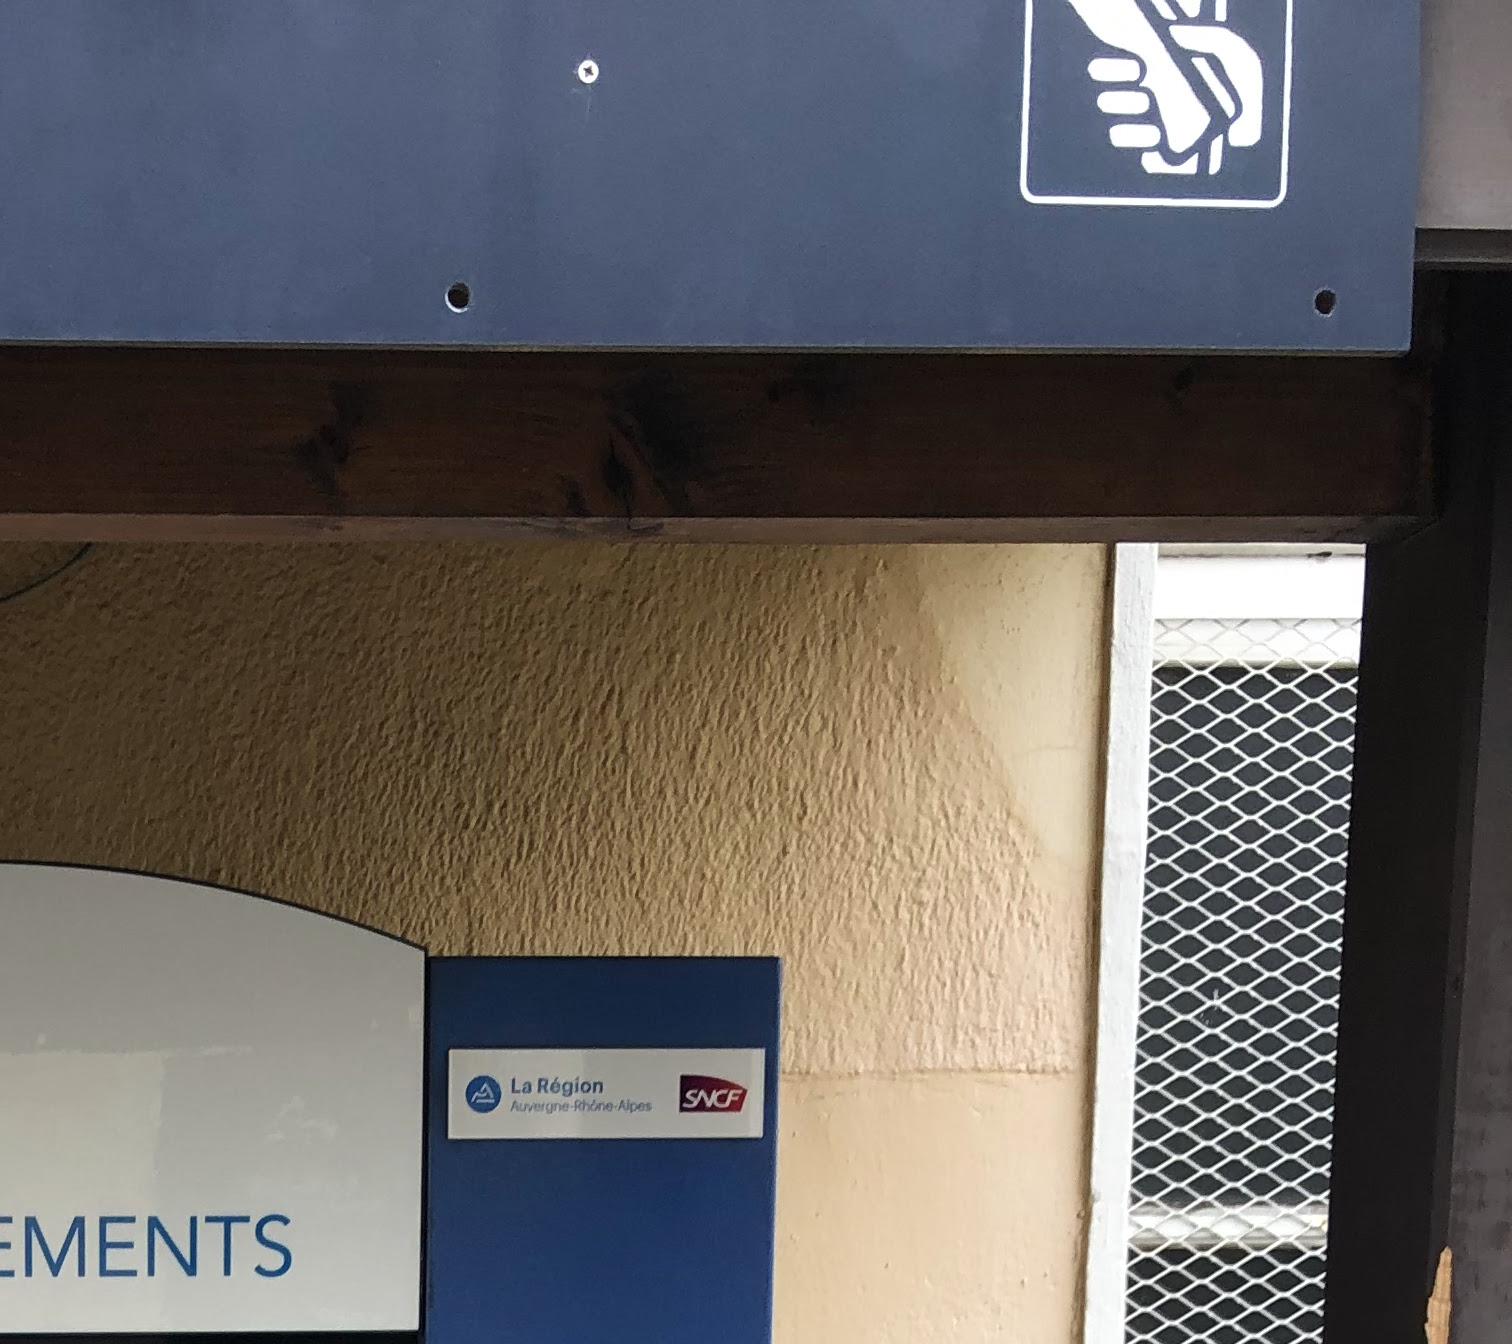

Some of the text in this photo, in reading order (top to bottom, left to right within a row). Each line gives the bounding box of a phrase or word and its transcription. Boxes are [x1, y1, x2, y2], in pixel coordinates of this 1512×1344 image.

[511, 1076, 743, 1109] La Région SNCF
[510, 1099, 652, 1115] Auvergne-Rhône-Alpes
